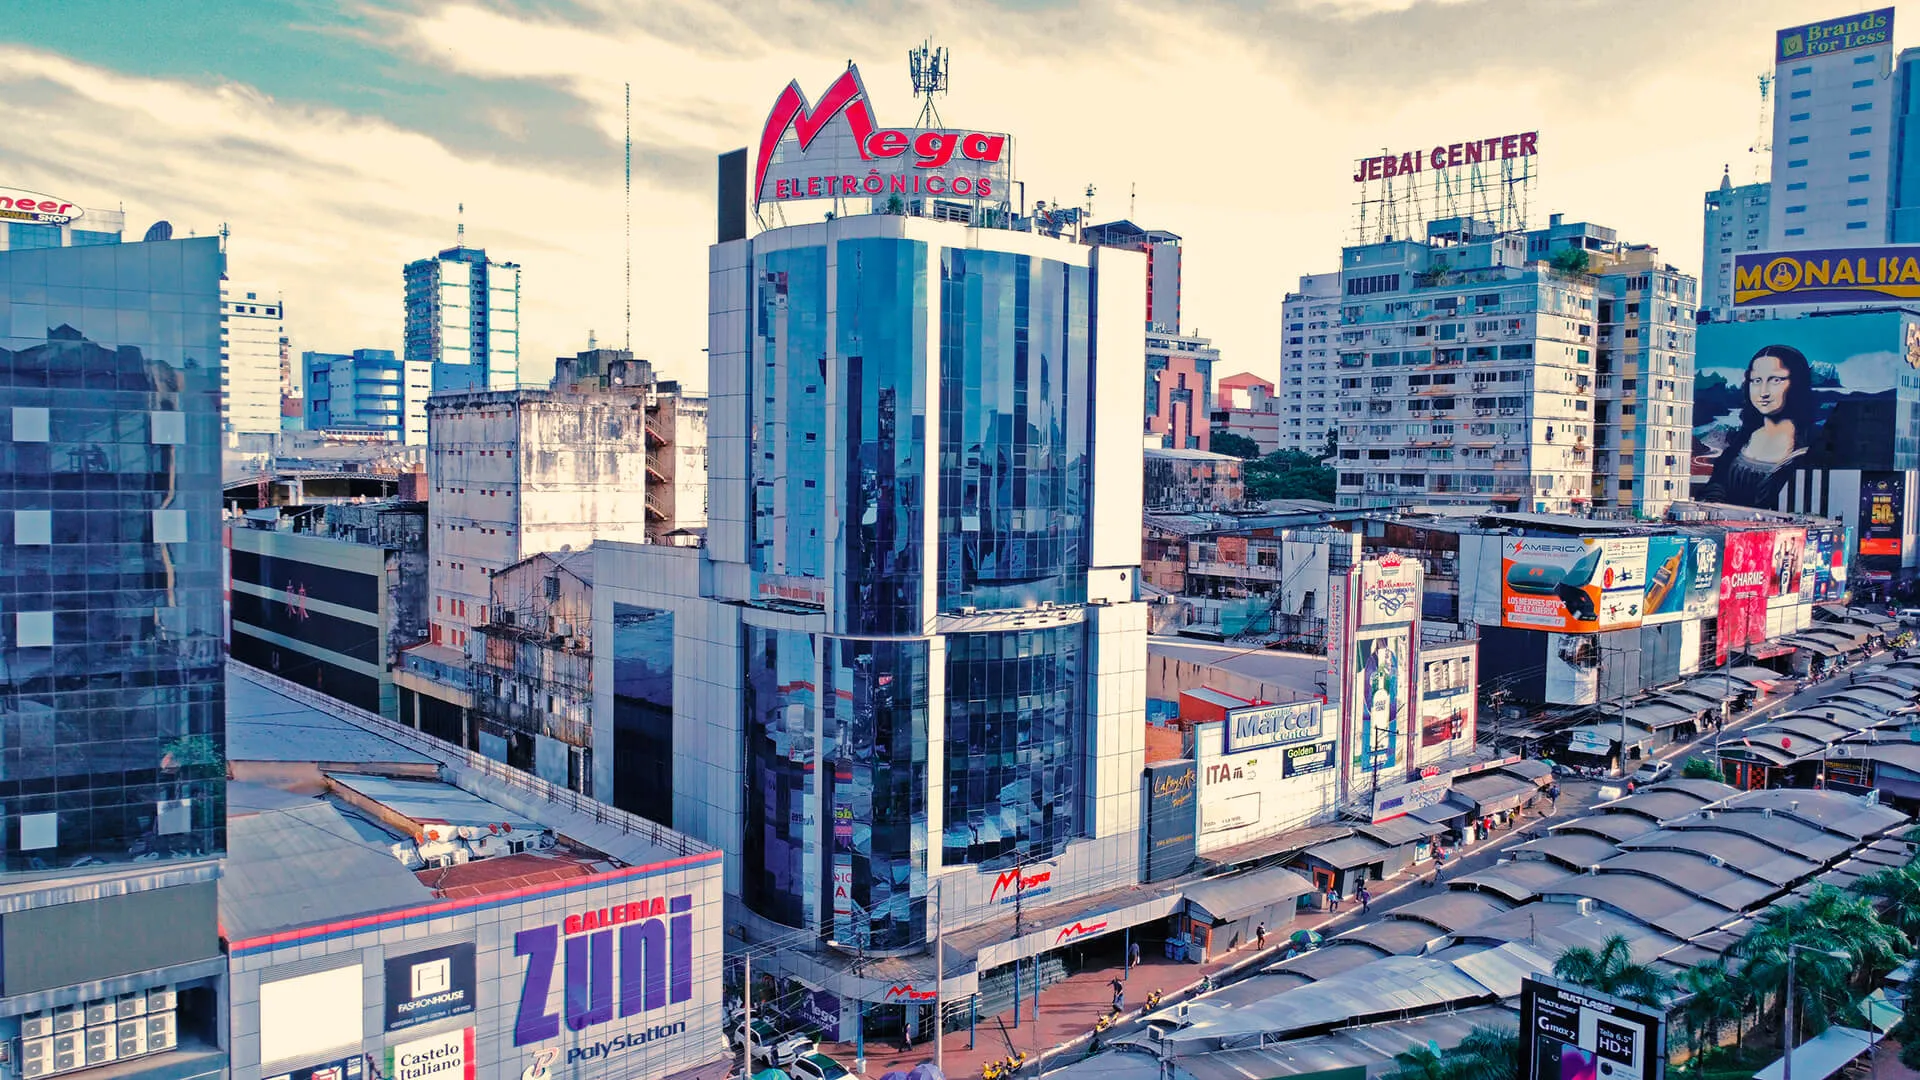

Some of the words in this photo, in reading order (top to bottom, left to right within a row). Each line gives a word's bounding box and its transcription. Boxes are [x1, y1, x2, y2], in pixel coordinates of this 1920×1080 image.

[1807, 14, 1887, 41] Brands
[1806, 40, 1839, 56] For
[1844, 31, 1886, 48] Less
[754, 62, 1005, 214] Mega
[1353, 151, 1423, 182] JEBAI
[1430, 132, 1538, 169] CENTER
[775, 169, 993, 199] ELETRÔNICOS
[38, 213, 70, 223] SHOP
[1735, 256, 1920, 292] MONALISA
[1731, 571, 1763, 588] CHARME
[1236, 706, 1318, 739] Marcel
[1288, 747, 1314, 758] Golden
[1316, 744, 1332, 752] Time
[1206, 763, 1231, 785] ITA
[564, 896, 666, 935] GALERIA
[566, 1021, 686, 1065] PolyStation
[1569, 1030, 1576, 1040] 2
[1600, 1036, 1632, 1057] HD+
[400, 1043, 459, 1067] Castelo
[400, 1058, 461, 1080] Italiano
